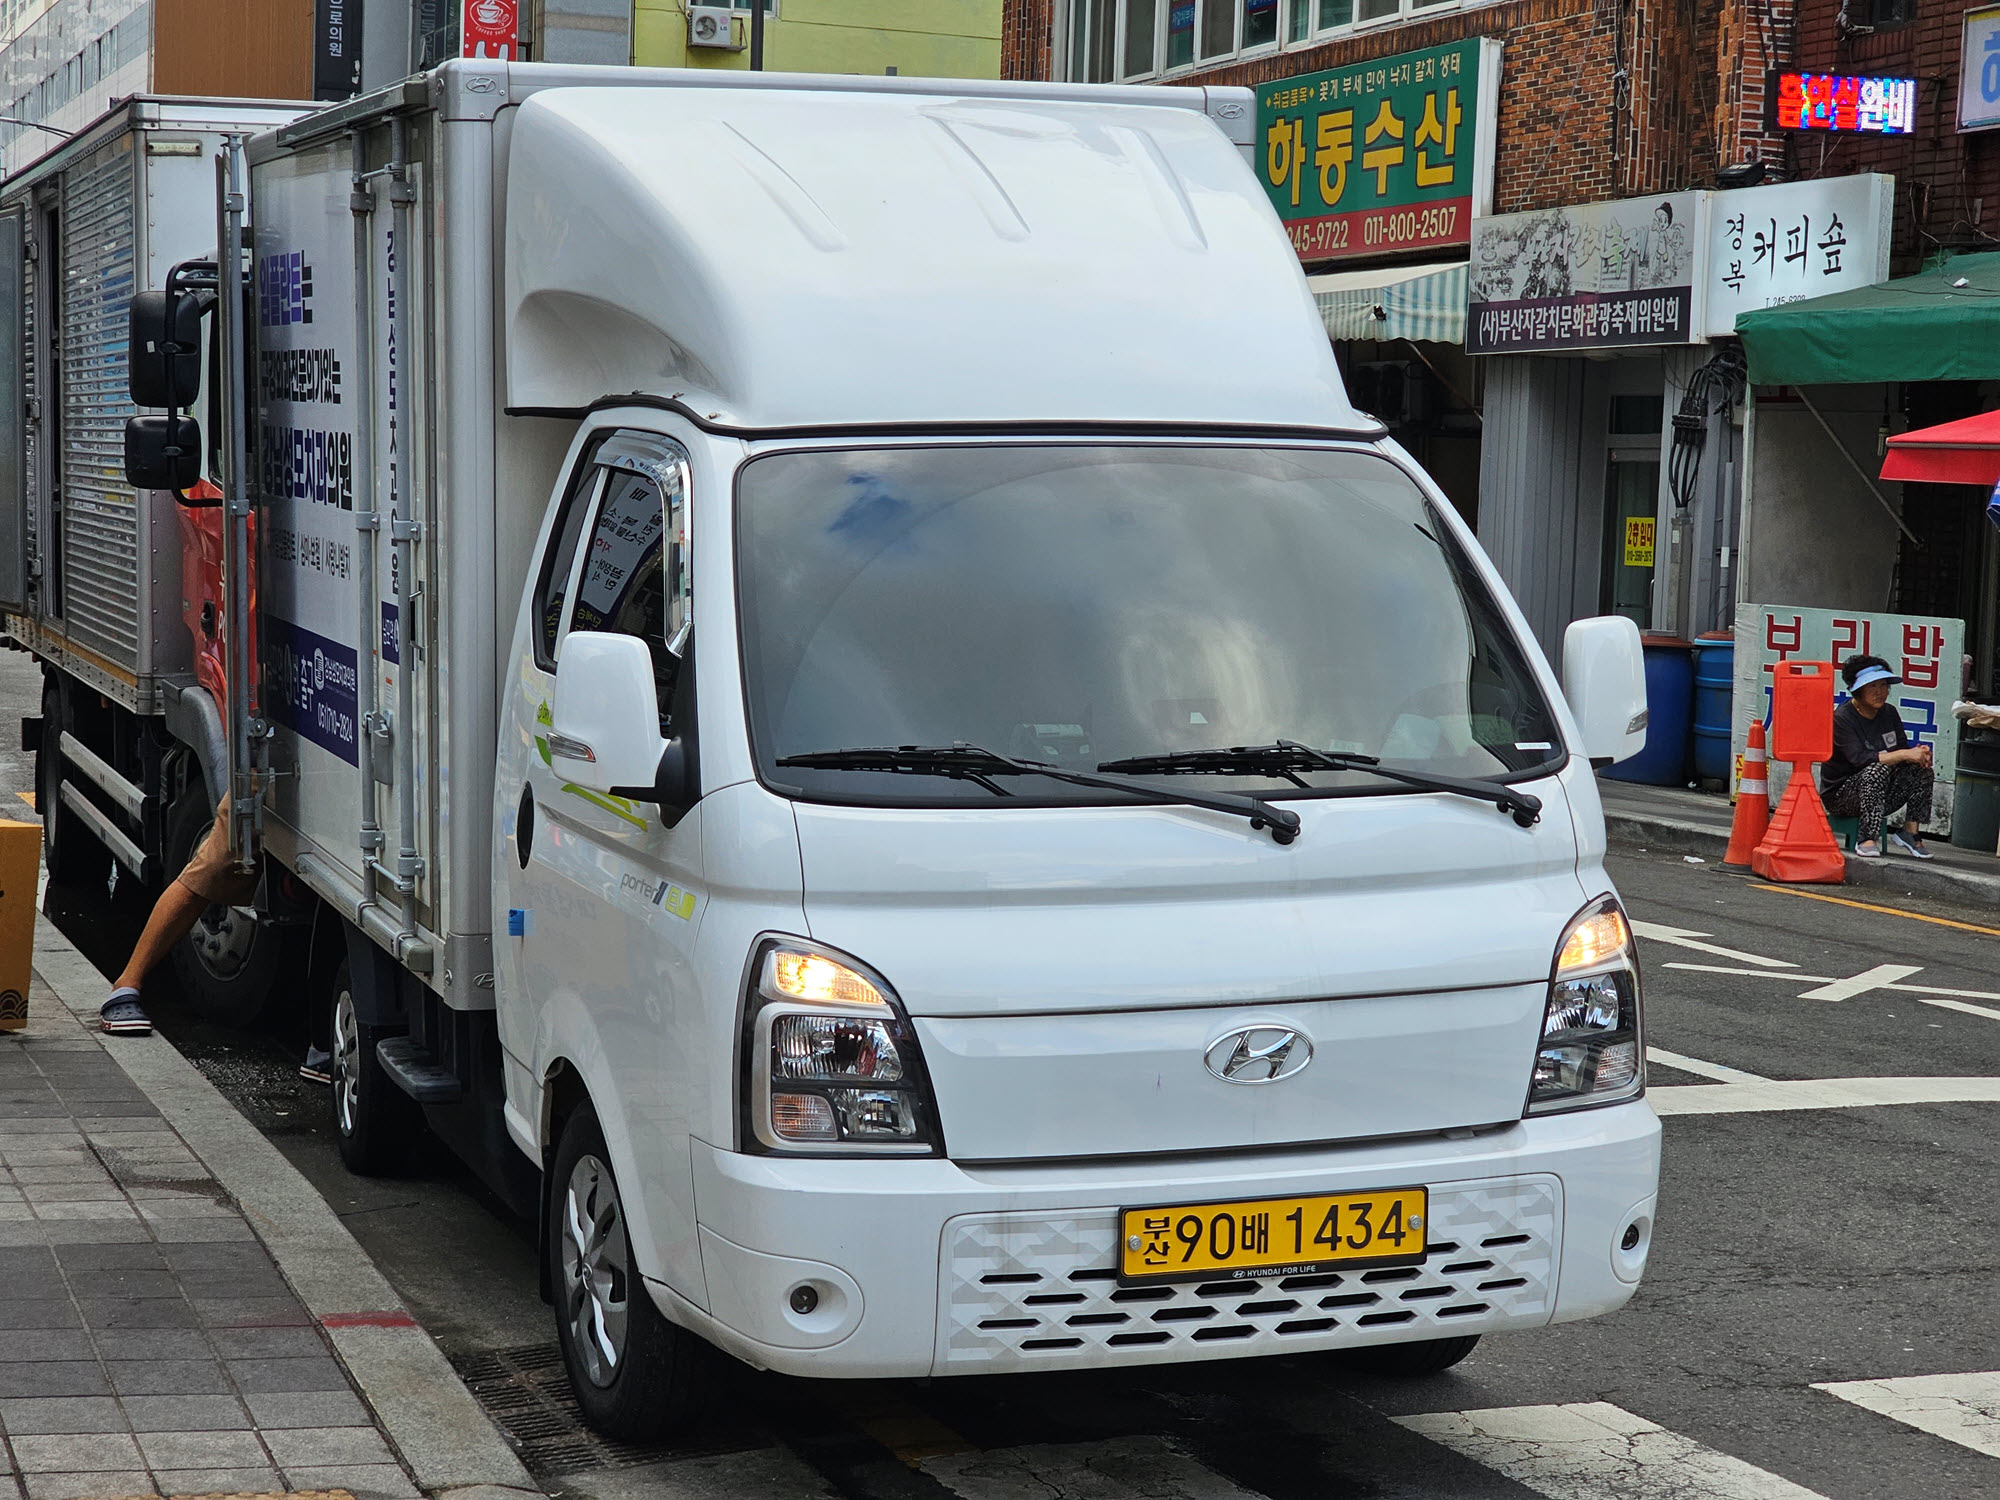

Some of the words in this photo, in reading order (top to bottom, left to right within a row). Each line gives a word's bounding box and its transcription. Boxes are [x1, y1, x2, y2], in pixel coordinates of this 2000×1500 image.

[1273, 87, 1307, 109] 취급품목
[1319, 78, 1338, 102] 꽃게
[1342, 74, 1362, 98] 부세
[1366, 70, 1386, 93] 민어
[1390, 63, 1411, 87] 낙지
[1415, 57, 1435, 80] 칼치
[1440, 52, 1461, 78] 생태
[1266, 86, 1463, 207] 하동수산
[1363, 206, 1457, 246] 011-800-2507
[1721, 213, 1746, 296] 경복
[260, 250, 313, 327] 임플란트는
[1479, 297, 1680, 346] (사)부산자갈치문화관광축제위원회
[263, 426, 352, 511] 강남성모치과의원
[1640, 522, 1653, 547] 임대
[301, 655, 314, 712] 출구
[620, 873, 656, 899] porter
[1143, 1216, 1170, 1265] 부산
[1175, 1211, 1269, 1263] 90배
[1286, 1199, 1406, 1254] 1434
[1247, 1266, 1281, 1277] HYUNDAI
[1282, 1266, 1299, 1275] FOR
[1299, 1264, 1316, 1274] LIFE
